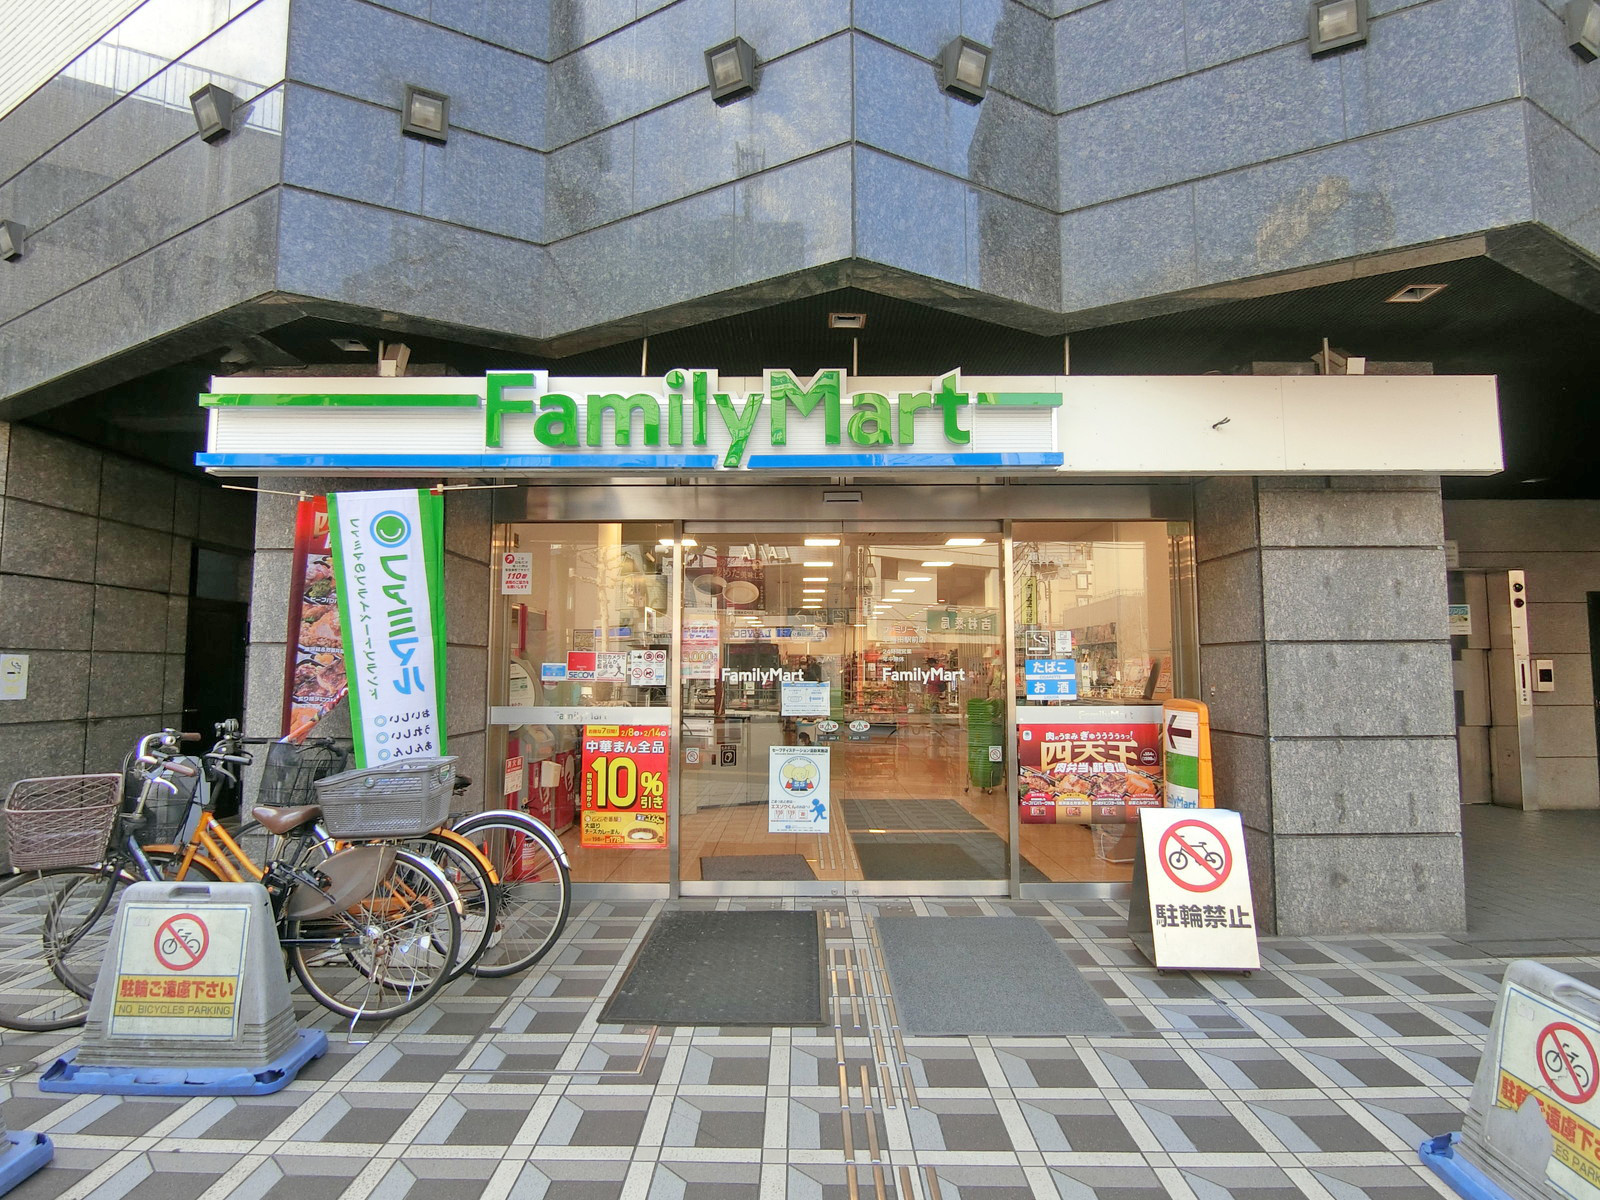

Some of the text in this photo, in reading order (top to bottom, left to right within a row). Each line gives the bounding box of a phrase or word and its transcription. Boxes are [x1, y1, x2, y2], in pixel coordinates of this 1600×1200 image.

[485, 369, 971, 468] FamilyMart
[1033, 661, 1067, 673] たばこ
[568, 671, 595, 679] SECOM
[722, 667, 804, 684] FamilyMart
[882, 667, 965, 684] FamilyMart
[586, 740, 665, 753] 中華まん全品
[1040, 740, 1139, 774] 四天王
[1054, 762, 1128, 773] 肉弁当 新登場
[640, 796, 664, 809] 引き
[1155, 904, 1252, 929] 駐輪禁止
[120, 979, 233, 999] 駐輪ご遠慮下さい
[118, 1004, 231, 1016] NO BICYCLES PARKING
